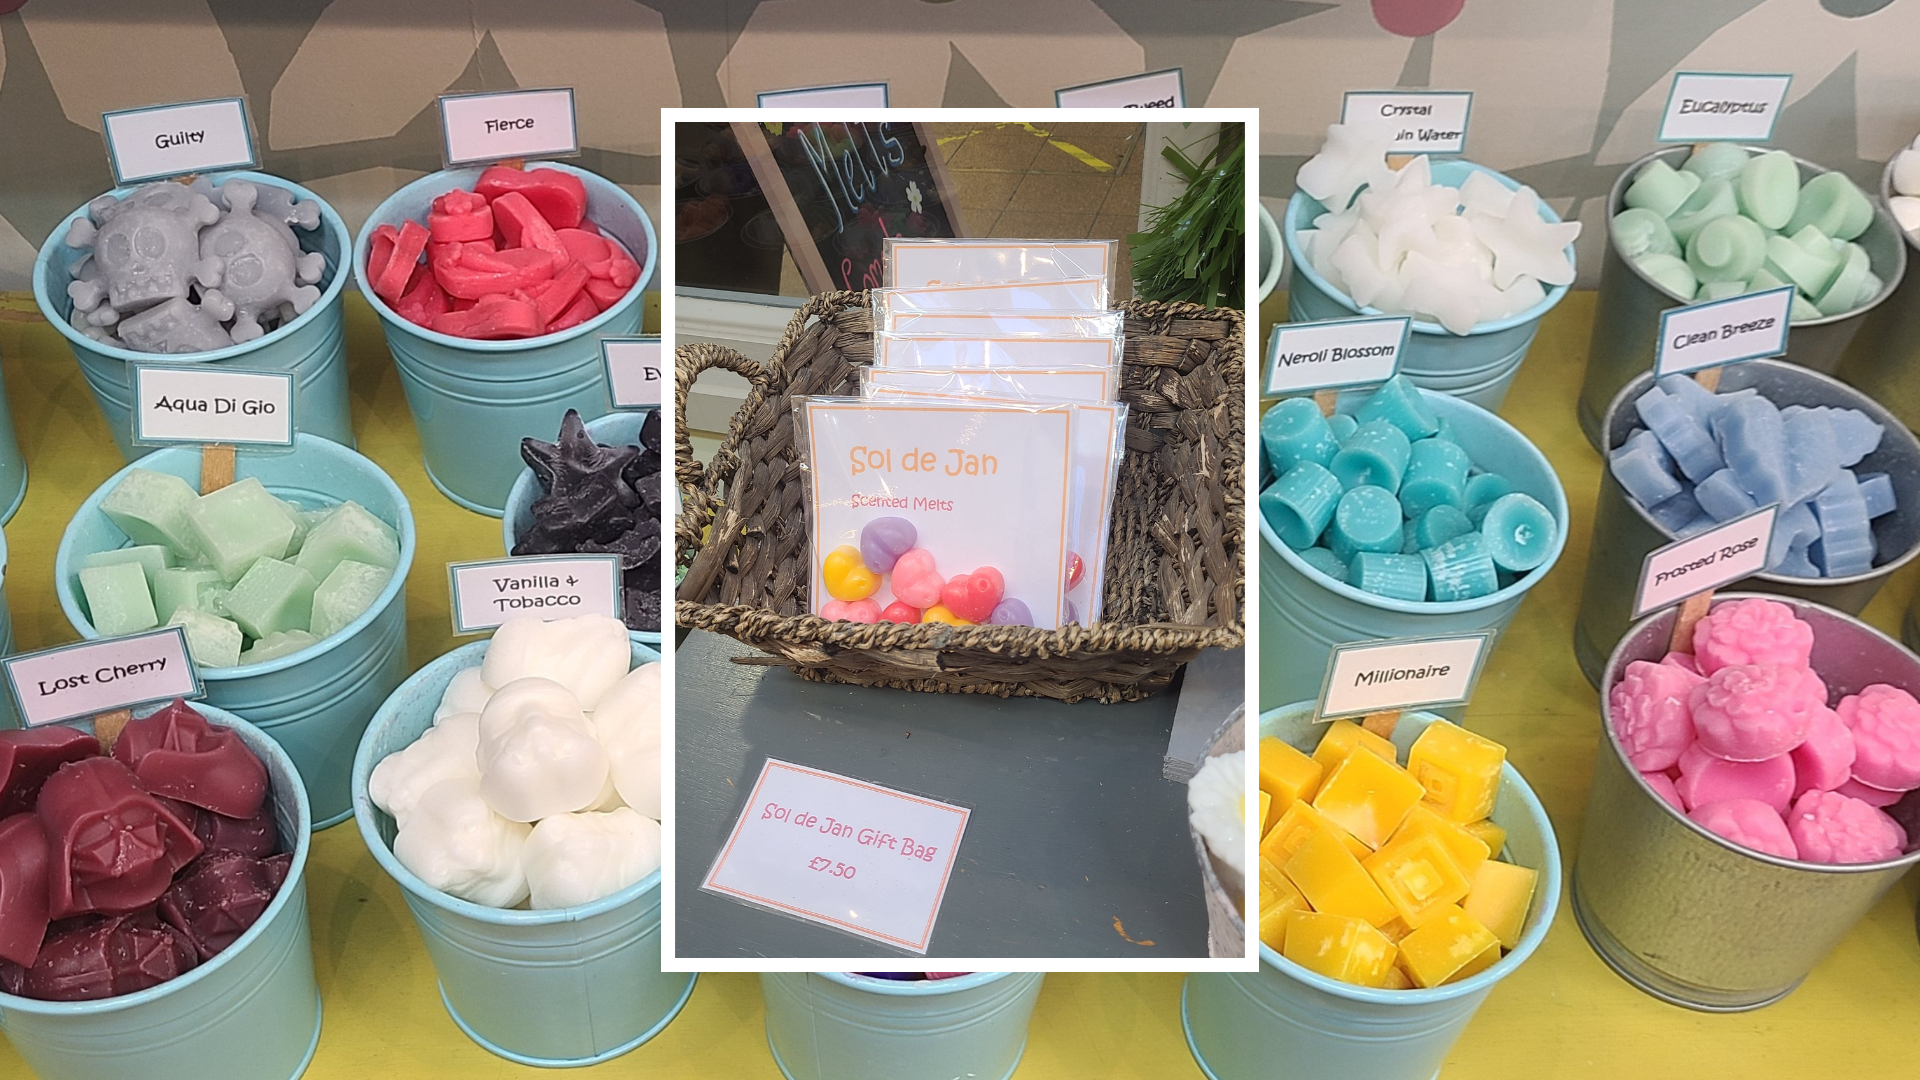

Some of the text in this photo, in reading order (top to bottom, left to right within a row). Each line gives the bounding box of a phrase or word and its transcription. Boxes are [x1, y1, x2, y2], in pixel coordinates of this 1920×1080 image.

[1122, 97, 1175, 108] eed
[1380, 104, 1432, 117] Crystal
[1679, 98, 1768, 114] Eucalyptus
[484, 116, 535, 134] Fierce
[1418, 128, 1464, 142] Water
[155, 129, 205, 150] Guilty
[1673, 316, 1775, 350] Clean Breeze
[1278, 343, 1395, 368] Neroli Blossom
[154, 395, 276, 416] Aqua Di Gio
[849, 445, 998, 477] Sol de Jan
[851, 494, 954, 512] Scented Melts
[1654, 535, 1759, 586] Frosted Rose
[493, 573, 578, 592] Vanilla &
[494, 592, 580, 612] Tobacco
[38, 656, 167, 697] Lost Cherry
[1355, 664, 1450, 687] Millionaire
[761, 802, 937, 863] Sol de Jan Gift Bag
[808, 856, 856, 880] £7.50
